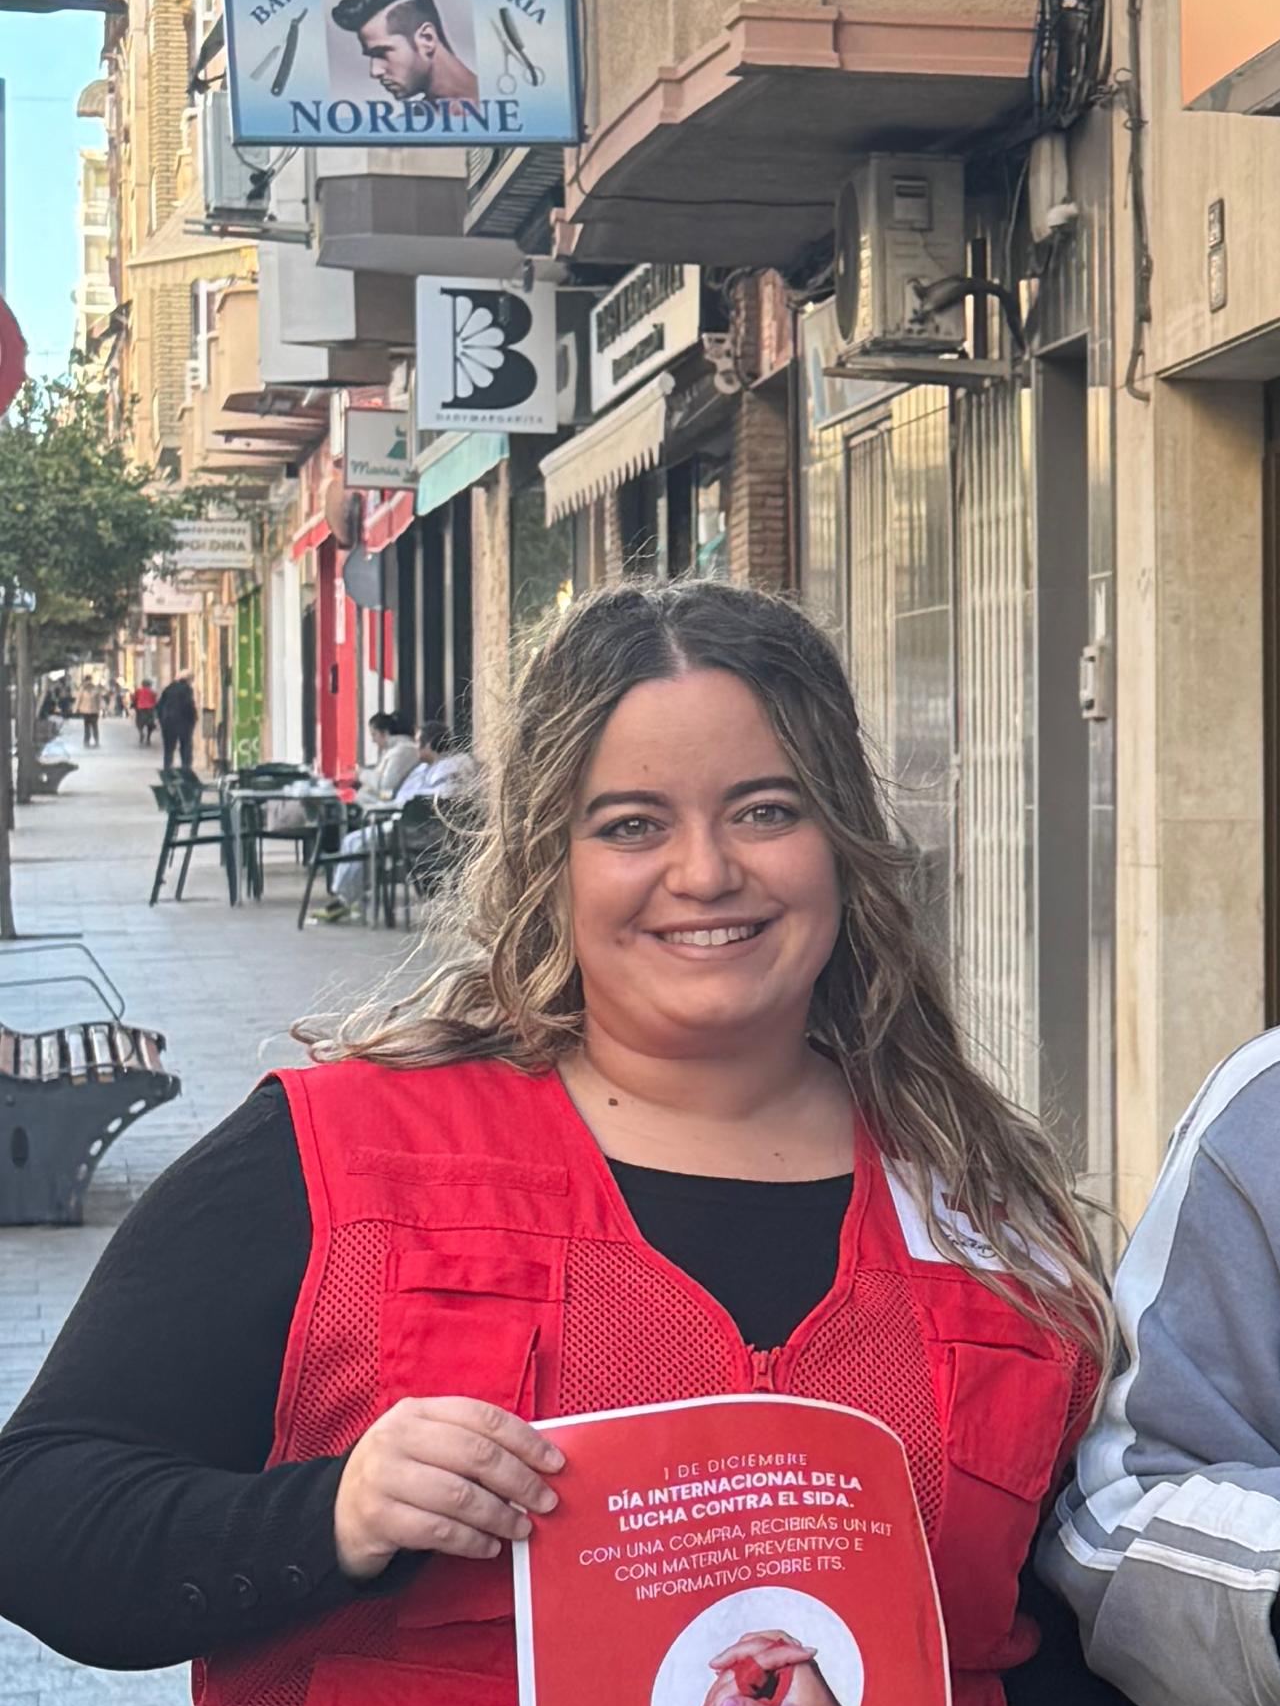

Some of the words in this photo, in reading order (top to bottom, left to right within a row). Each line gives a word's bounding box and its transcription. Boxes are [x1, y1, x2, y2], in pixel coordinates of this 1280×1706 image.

[289, 98, 524, 135] NORDINE
[678, 1463, 701, 1479] DE
[708, 1453, 808, 1473] DICIEMBRE
[608, 1489, 644, 1512] DÍA
[648, 1471, 807, 1506] INTERNACIONAL
[811, 1471, 837, 1488] DE
[839, 1473, 863, 1491] LA
[619, 1508, 688, 1532] LUCHA
[692, 1493, 773, 1520] CONTRA
[777, 1491, 799, 1506] EL
[802, 1491, 855, 1508] SIDA.
[579, 1544, 621, 1566] CON
[626, 1538, 664, 1559] UNA
[669, 1524, 747, 1553] COMPRA,
[750, 1513, 839, 1536] RECIBIRÁS
[843, 1517, 867, 1533] UN
[869, 1520, 894, 1537] KIT
[614, 1561, 657, 1582] CON
[662, 1545, 740, 1577] MATERIAL
[744, 1536, 850, 1559] PREVENTIVO
[853, 1537, 864, 1552] E
[635, 1564, 752, 1601] INFORMATIVO
[756, 1556, 813, 1579] SOBRE
[816, 1555, 846, 1572] ITS.
